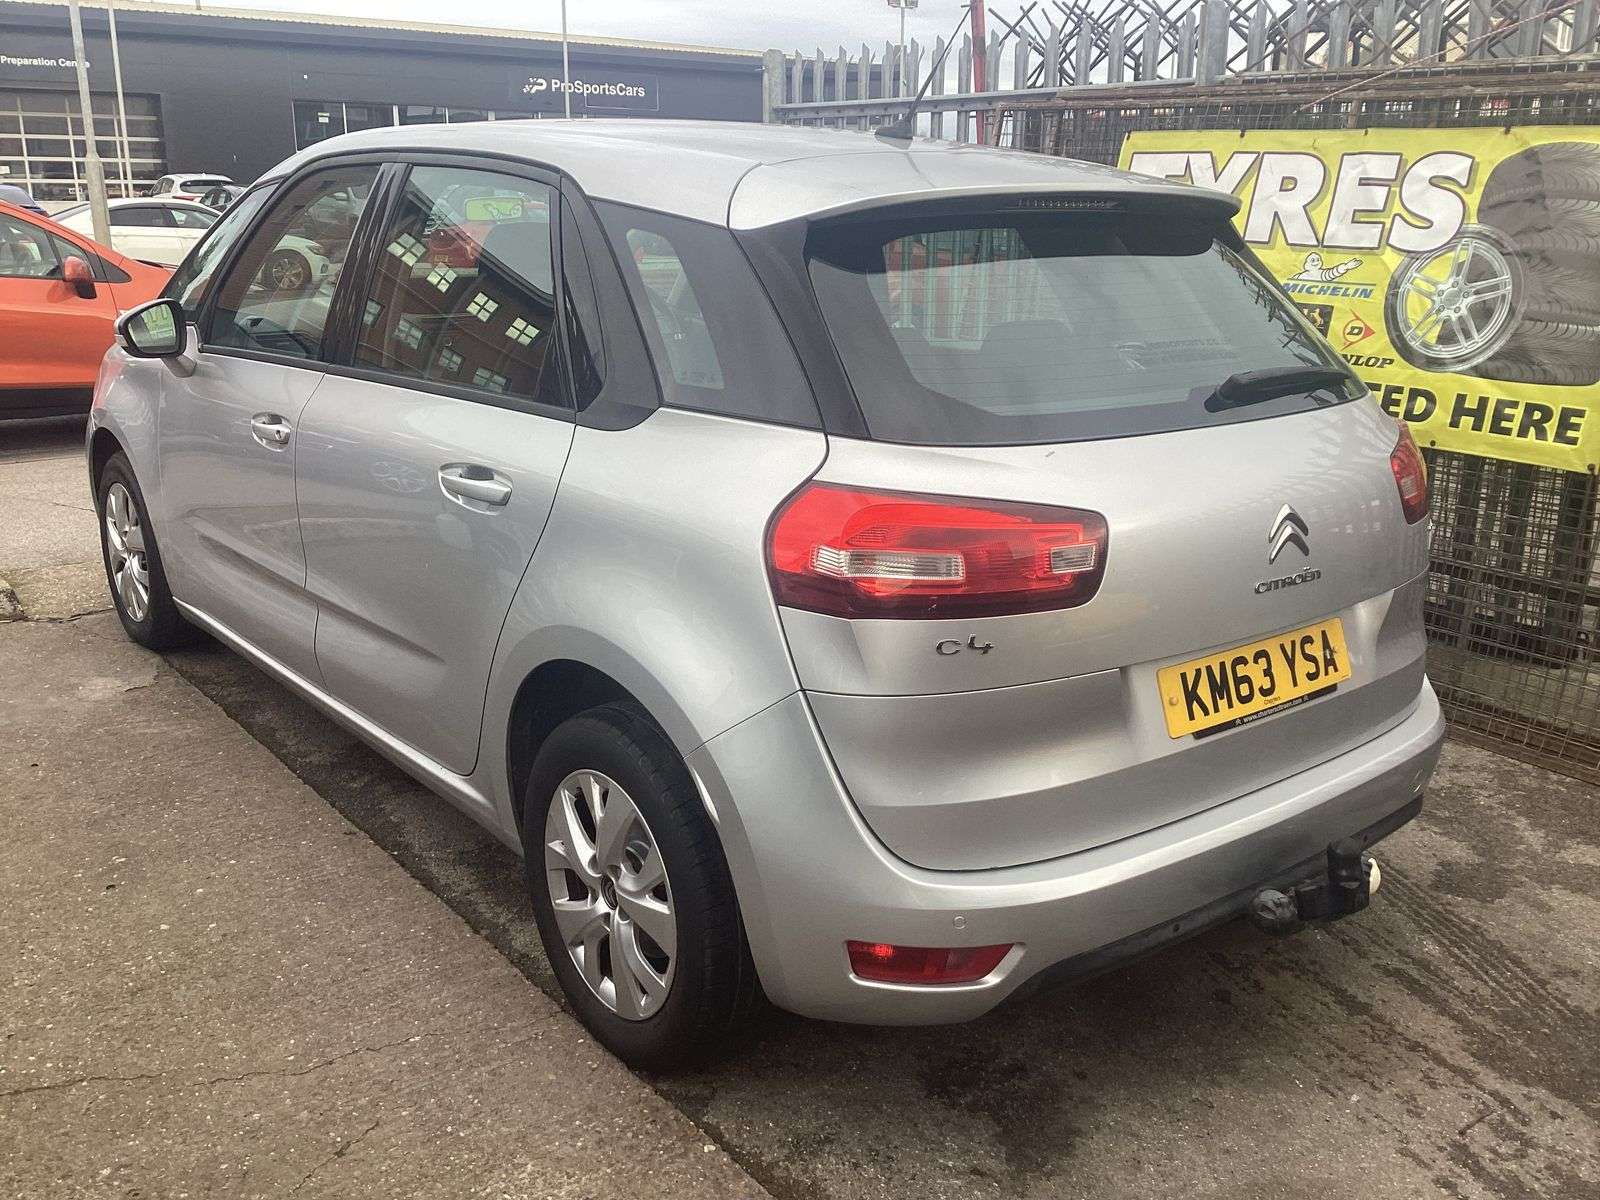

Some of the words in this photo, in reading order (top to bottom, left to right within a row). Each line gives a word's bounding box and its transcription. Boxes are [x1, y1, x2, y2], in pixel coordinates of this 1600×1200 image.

[0, 55, 57, 66] Preparation
[59, 58, 91, 69] Cene
[551, 79, 646, 97] ProSportsCars
[1282, 282, 1374, 299] MICHELIN
[1448, 392, 1587, 446] HERE
[935, 633, 995, 656] C4
[1179, 648, 1277, 722] KM63
[1279, 629, 1339, 688] YSA
